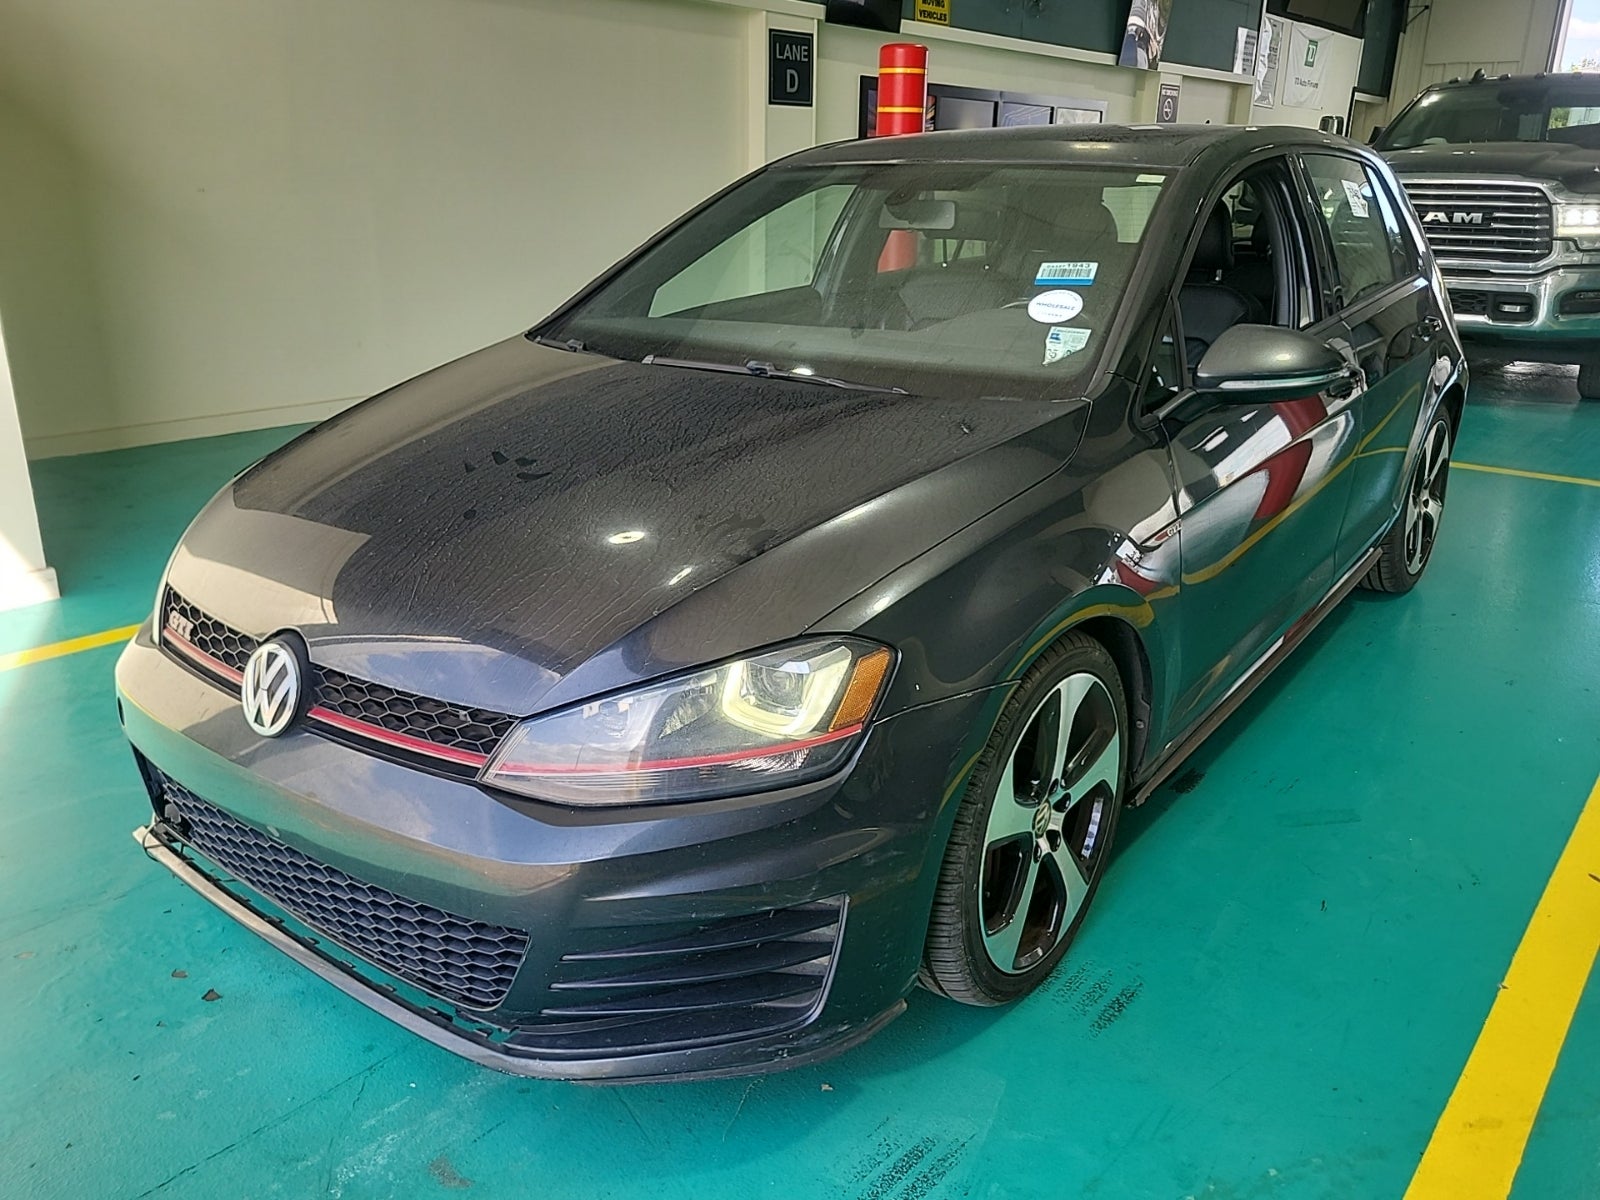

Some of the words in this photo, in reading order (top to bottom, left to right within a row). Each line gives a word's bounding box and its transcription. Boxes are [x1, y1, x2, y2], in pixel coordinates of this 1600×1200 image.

[918, 9, 948, 22] VEHICLES
[776, 42, 809, 62] LANE
[786, 69, 799, 93] D
[1422, 211, 1484, 225] AM
[1036, 301, 1076, 311] WHOLESALE
[1166, 520, 1183, 537] GTI
[168, 609, 195, 642] GTI
